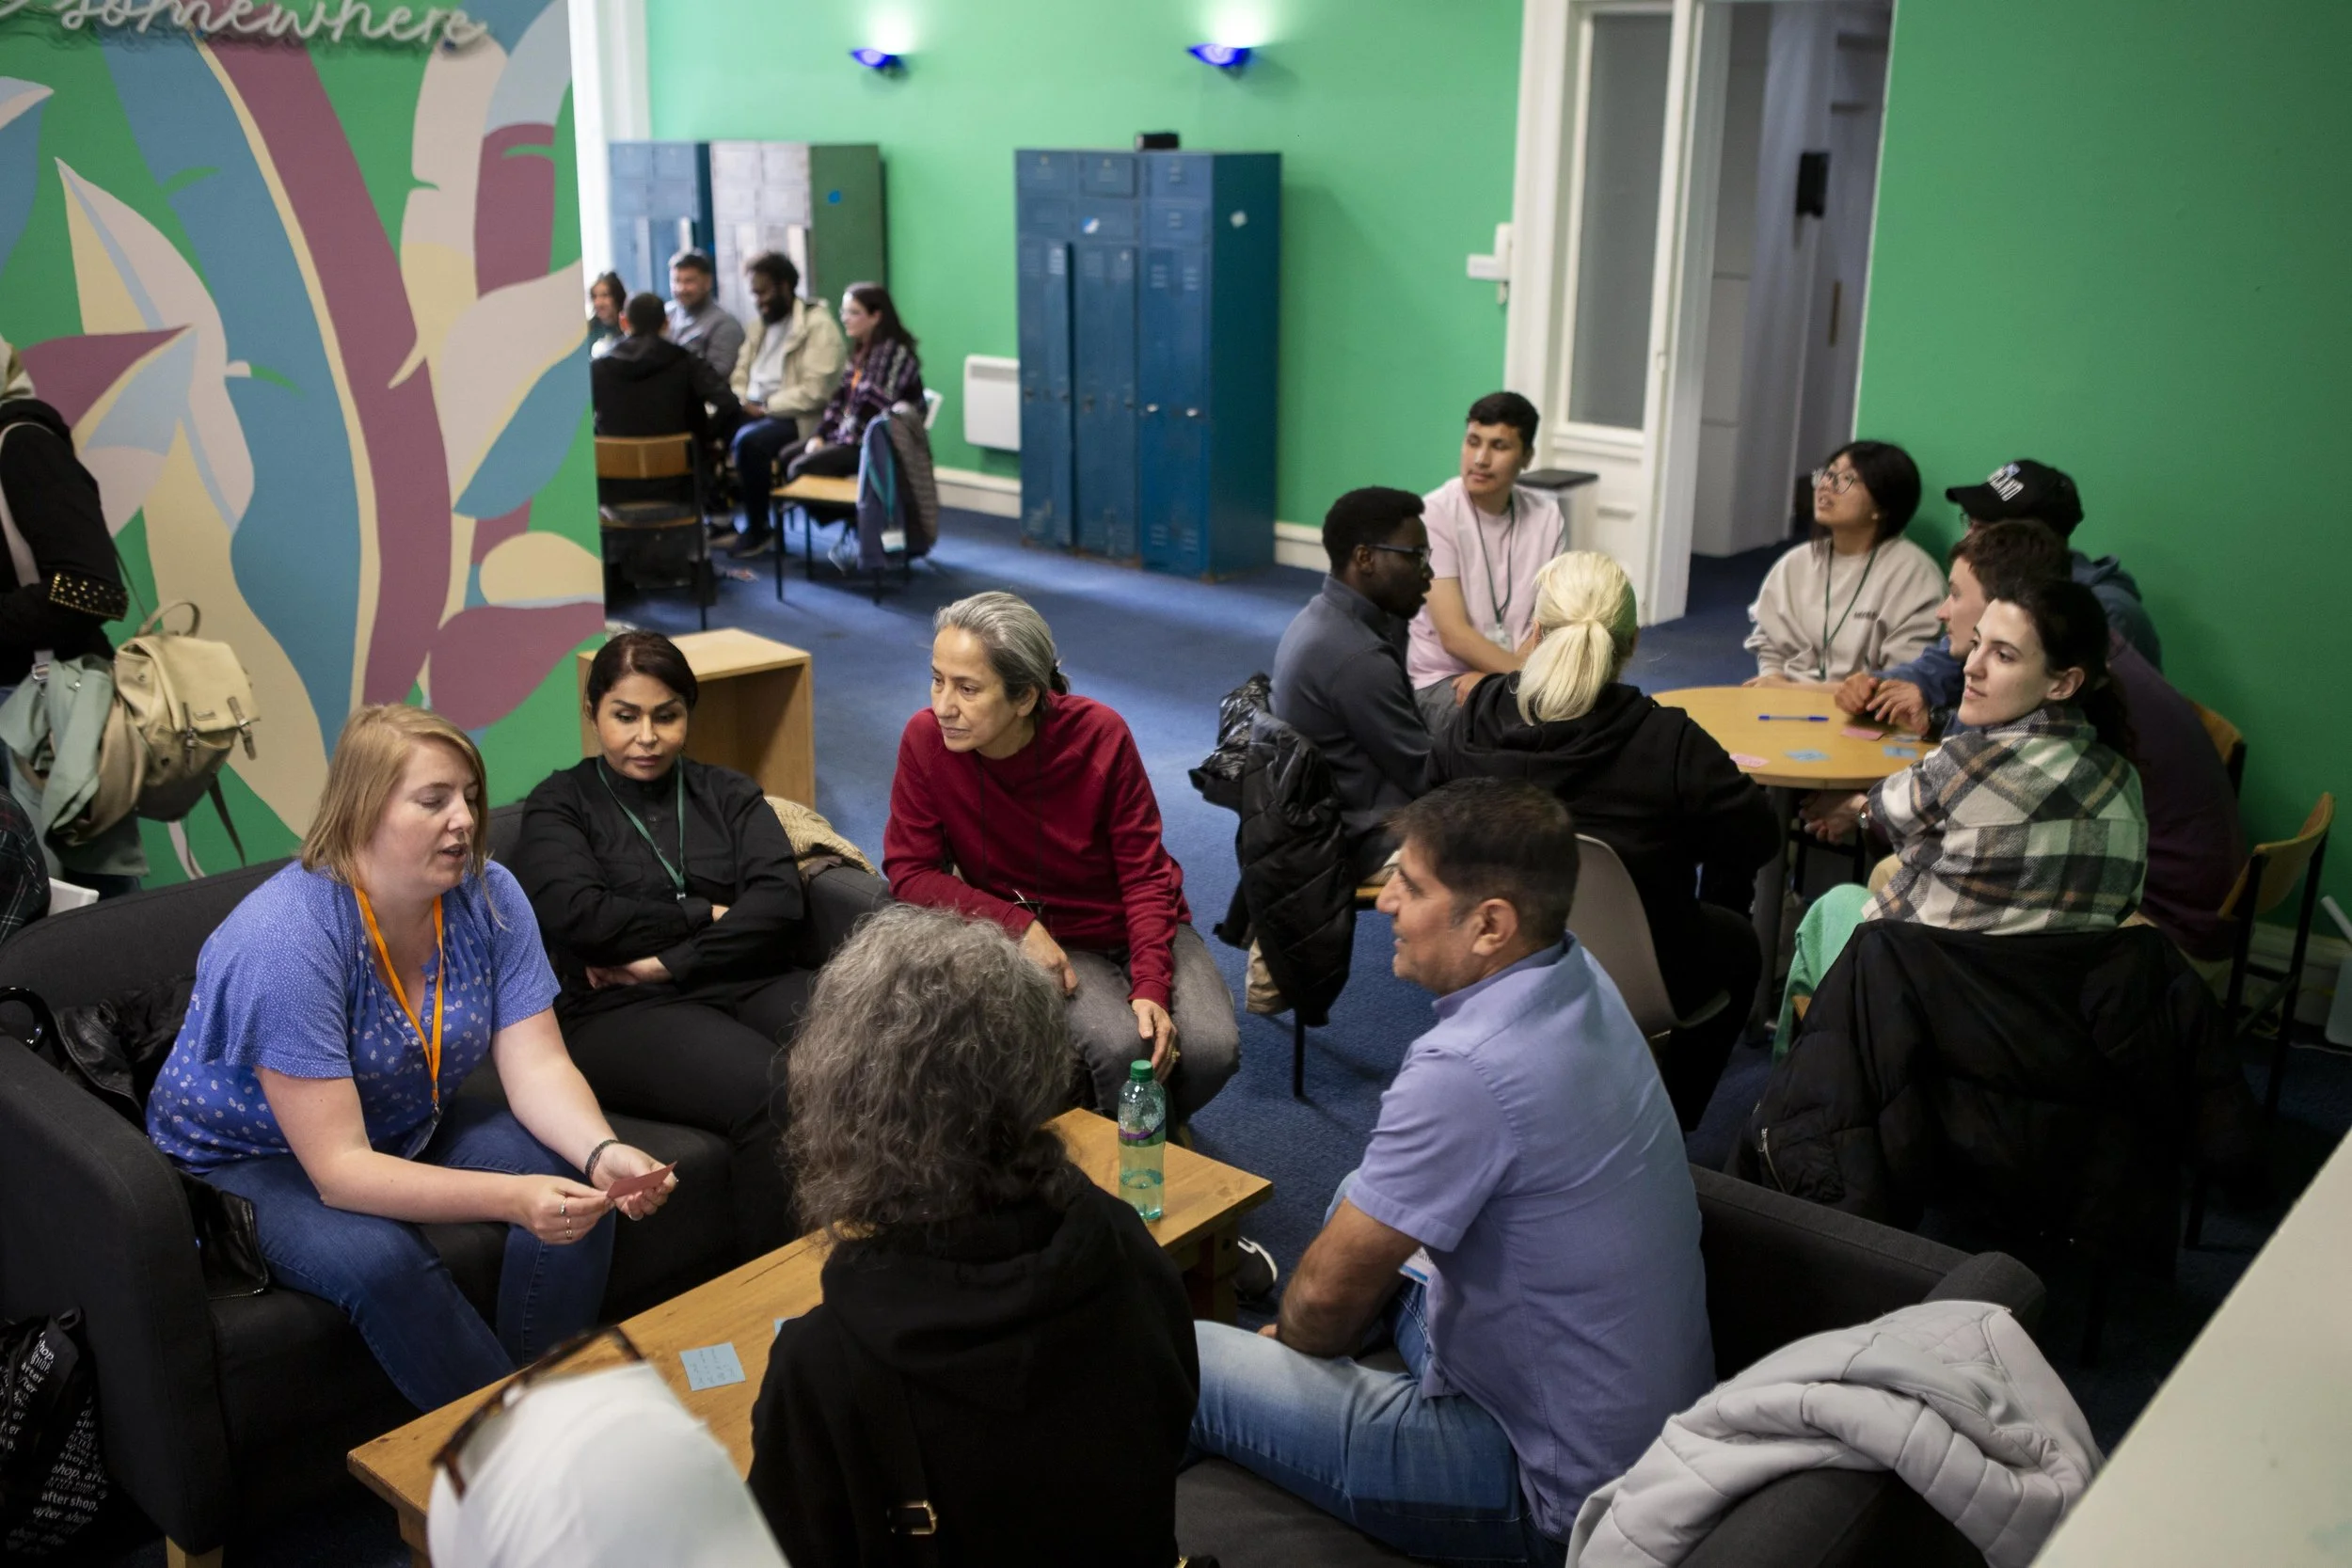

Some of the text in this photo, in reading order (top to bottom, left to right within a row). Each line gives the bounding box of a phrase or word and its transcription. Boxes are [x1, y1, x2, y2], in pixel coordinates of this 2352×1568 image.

[55, 0, 487, 44] somewhere
[41, 1490, 99, 1513] after shop,
